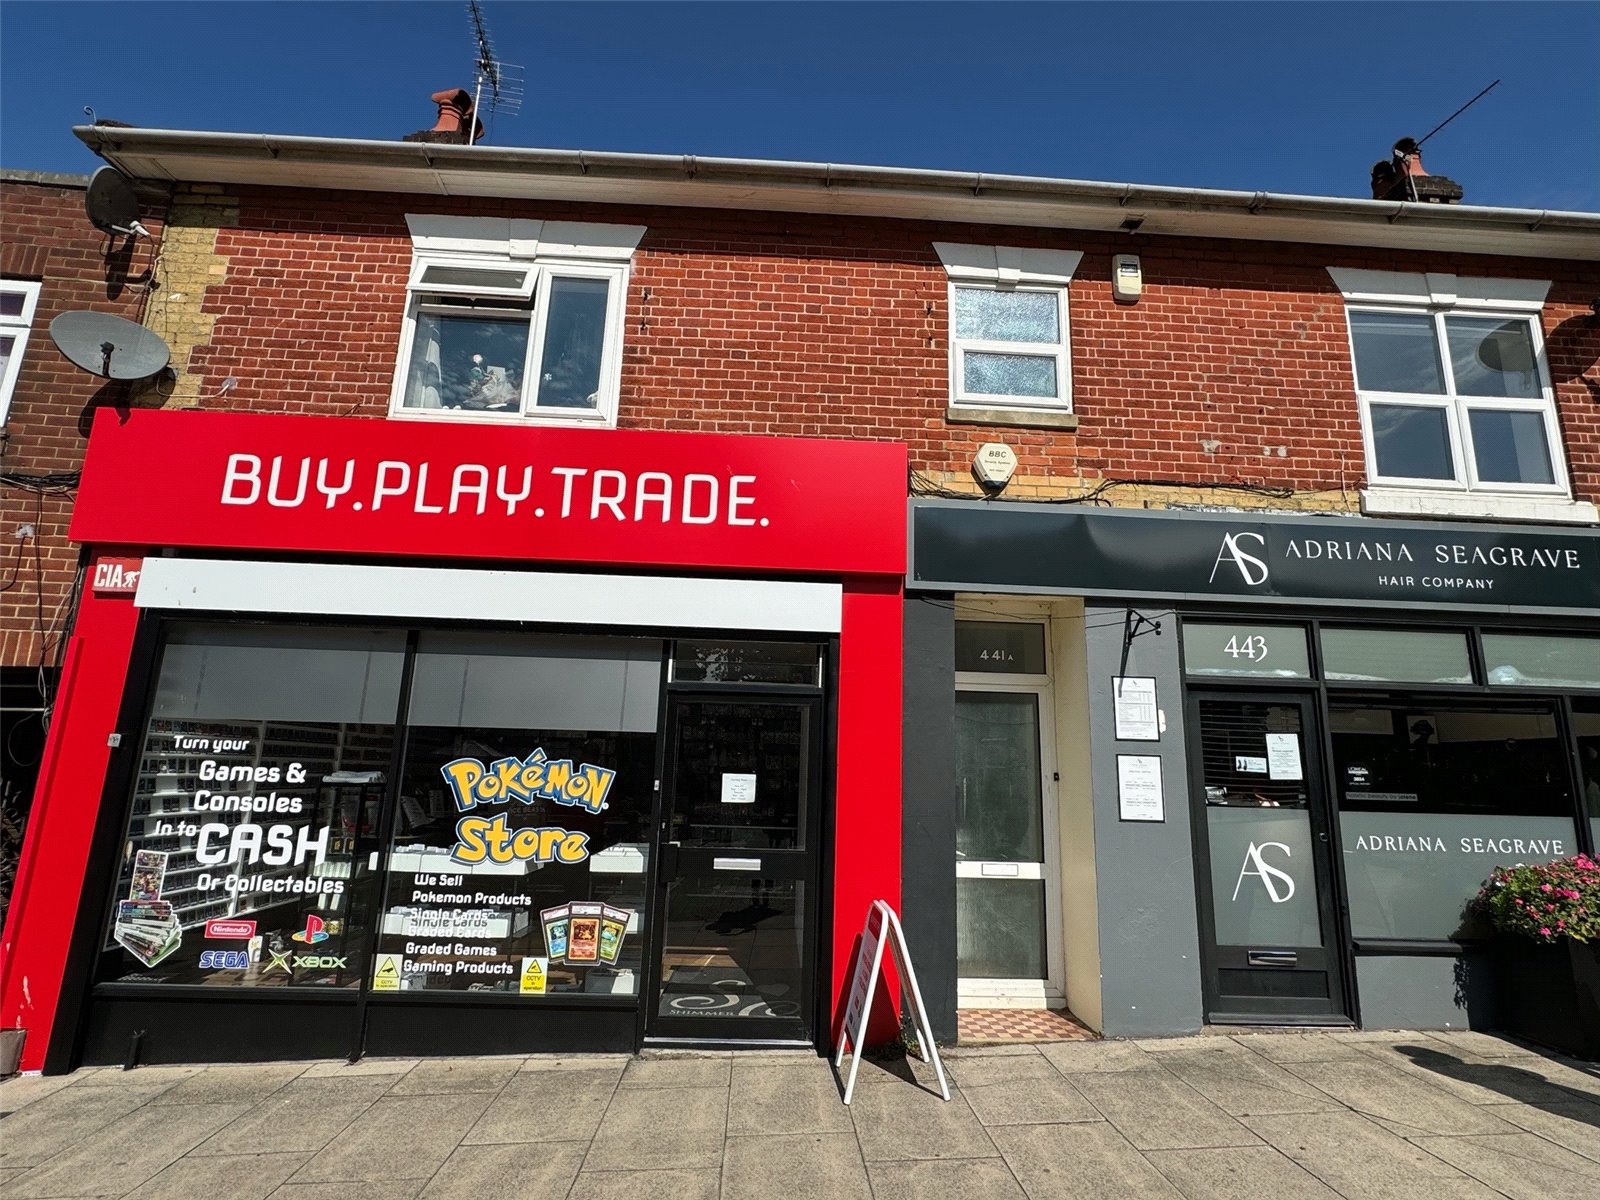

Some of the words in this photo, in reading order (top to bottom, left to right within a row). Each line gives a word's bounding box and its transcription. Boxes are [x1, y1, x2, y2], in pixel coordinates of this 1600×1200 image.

[1209, 531, 1269, 585] AS
[1286, 539, 1414, 562] ADRIANA
[1435, 545, 1580, 568] SEAGRAVE
[94, 563, 123, 588] CIA
[1379, 575, 1414, 587] HAIR
[1422, 577, 1494, 589] COMPANY
[1224, 635, 1268, 662] 443
[173, 735, 210, 750] Turn
[212, 739, 250, 753] your
[199, 760, 281, 783] Games
[286, 762, 307, 784] &
[193, 790, 303, 813] Consoles
[154, 820, 173, 836] In
[178, 821, 198, 837] to
[195, 823, 330, 867] CASH
[450, 812, 591, 865] Store
[1356, 835, 1447, 852] ADRIANA
[1460, 838, 1564, 855] SEAGRAVE
[414, 874, 438, 886] We
[439, 874, 464, 886] Sell
[1232, 841, 1295, 902] AS
[197, 874, 218, 891] Or
[225, 874, 345, 894] Collectables
[412, 890, 472, 904] Pokemon
[474, 892, 532, 906] Products
[410, 907, 450, 921] Single
[453, 908, 489, 921] Cards
[212, 925, 249, 934] Nintendo
[405, 941, 452, 955] Graded
[454, 943, 497, 957] Games
[199, 951, 250, 969] SEGA
[291, 955, 348, 969] XBOX
[403, 959, 452, 976] Gaming
[455, 961, 514, 975] Products
